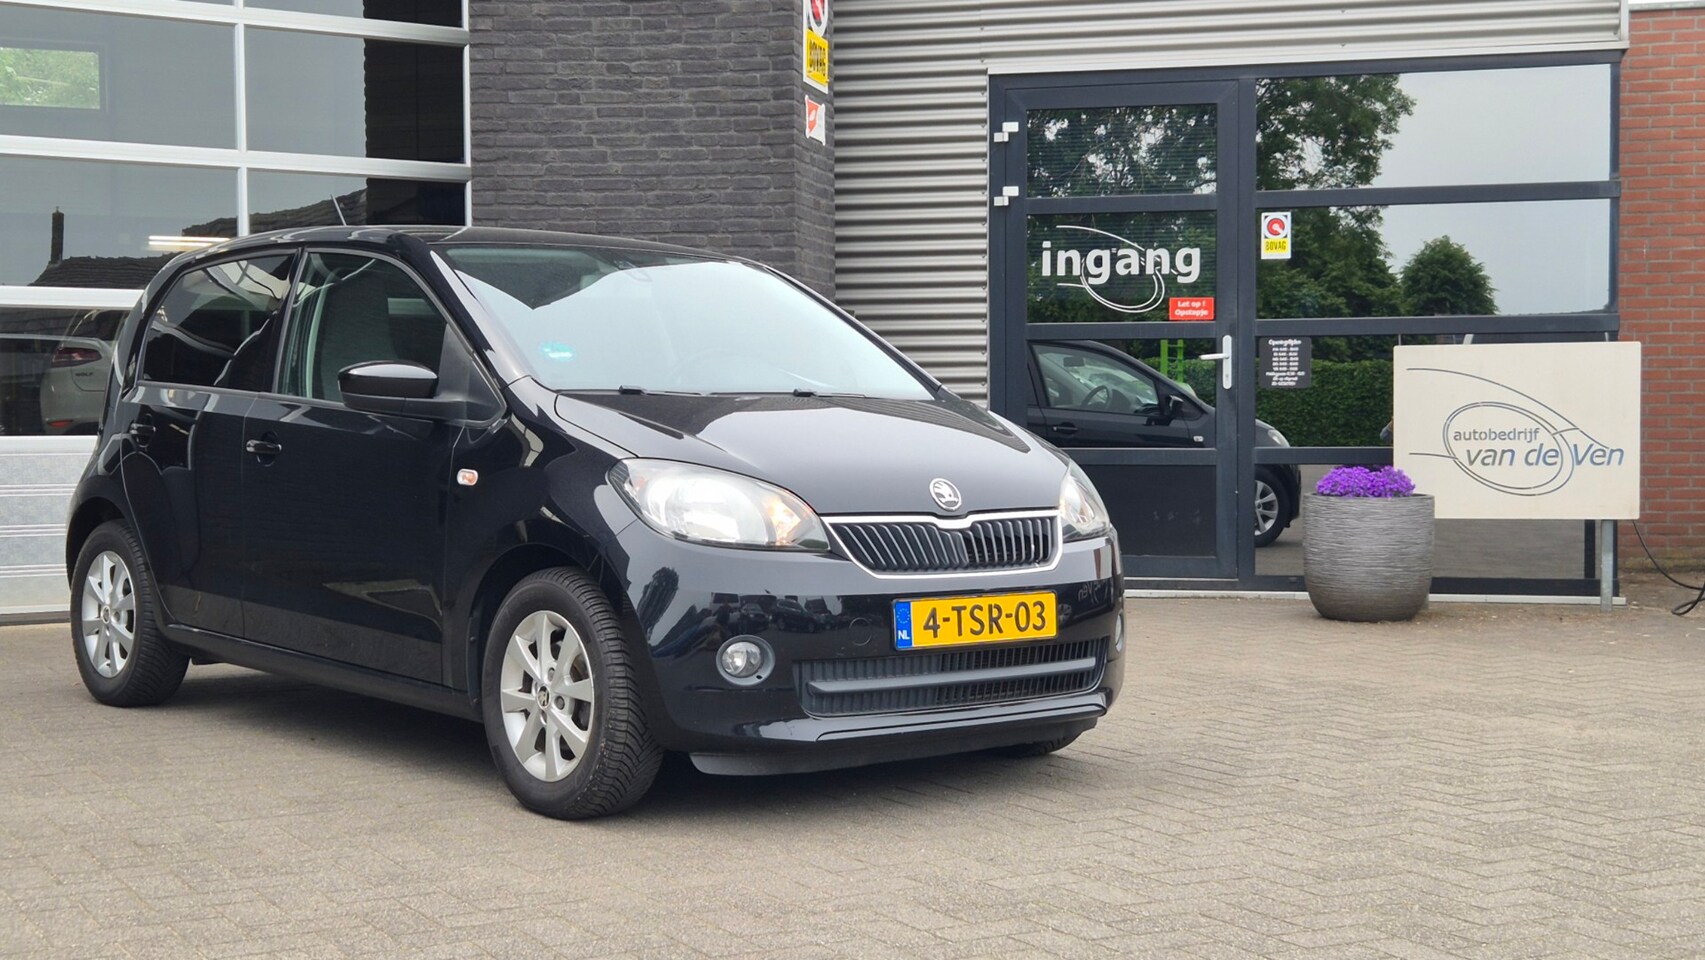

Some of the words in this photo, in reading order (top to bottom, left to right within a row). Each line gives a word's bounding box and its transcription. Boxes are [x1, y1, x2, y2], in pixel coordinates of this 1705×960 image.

[1265, 240, 1287, 251] BOVAG
[1041, 240, 1201, 284] ingang
[1453, 427, 1540, 443] autobedrijf
[1465, 446, 1516, 467] van
[1524, 442, 1560, 467] de
[1571, 443, 1625, 467] Ven
[923, 600, 1047, 639] 4-TSR-03
[898, 630, 911, 640] NL
